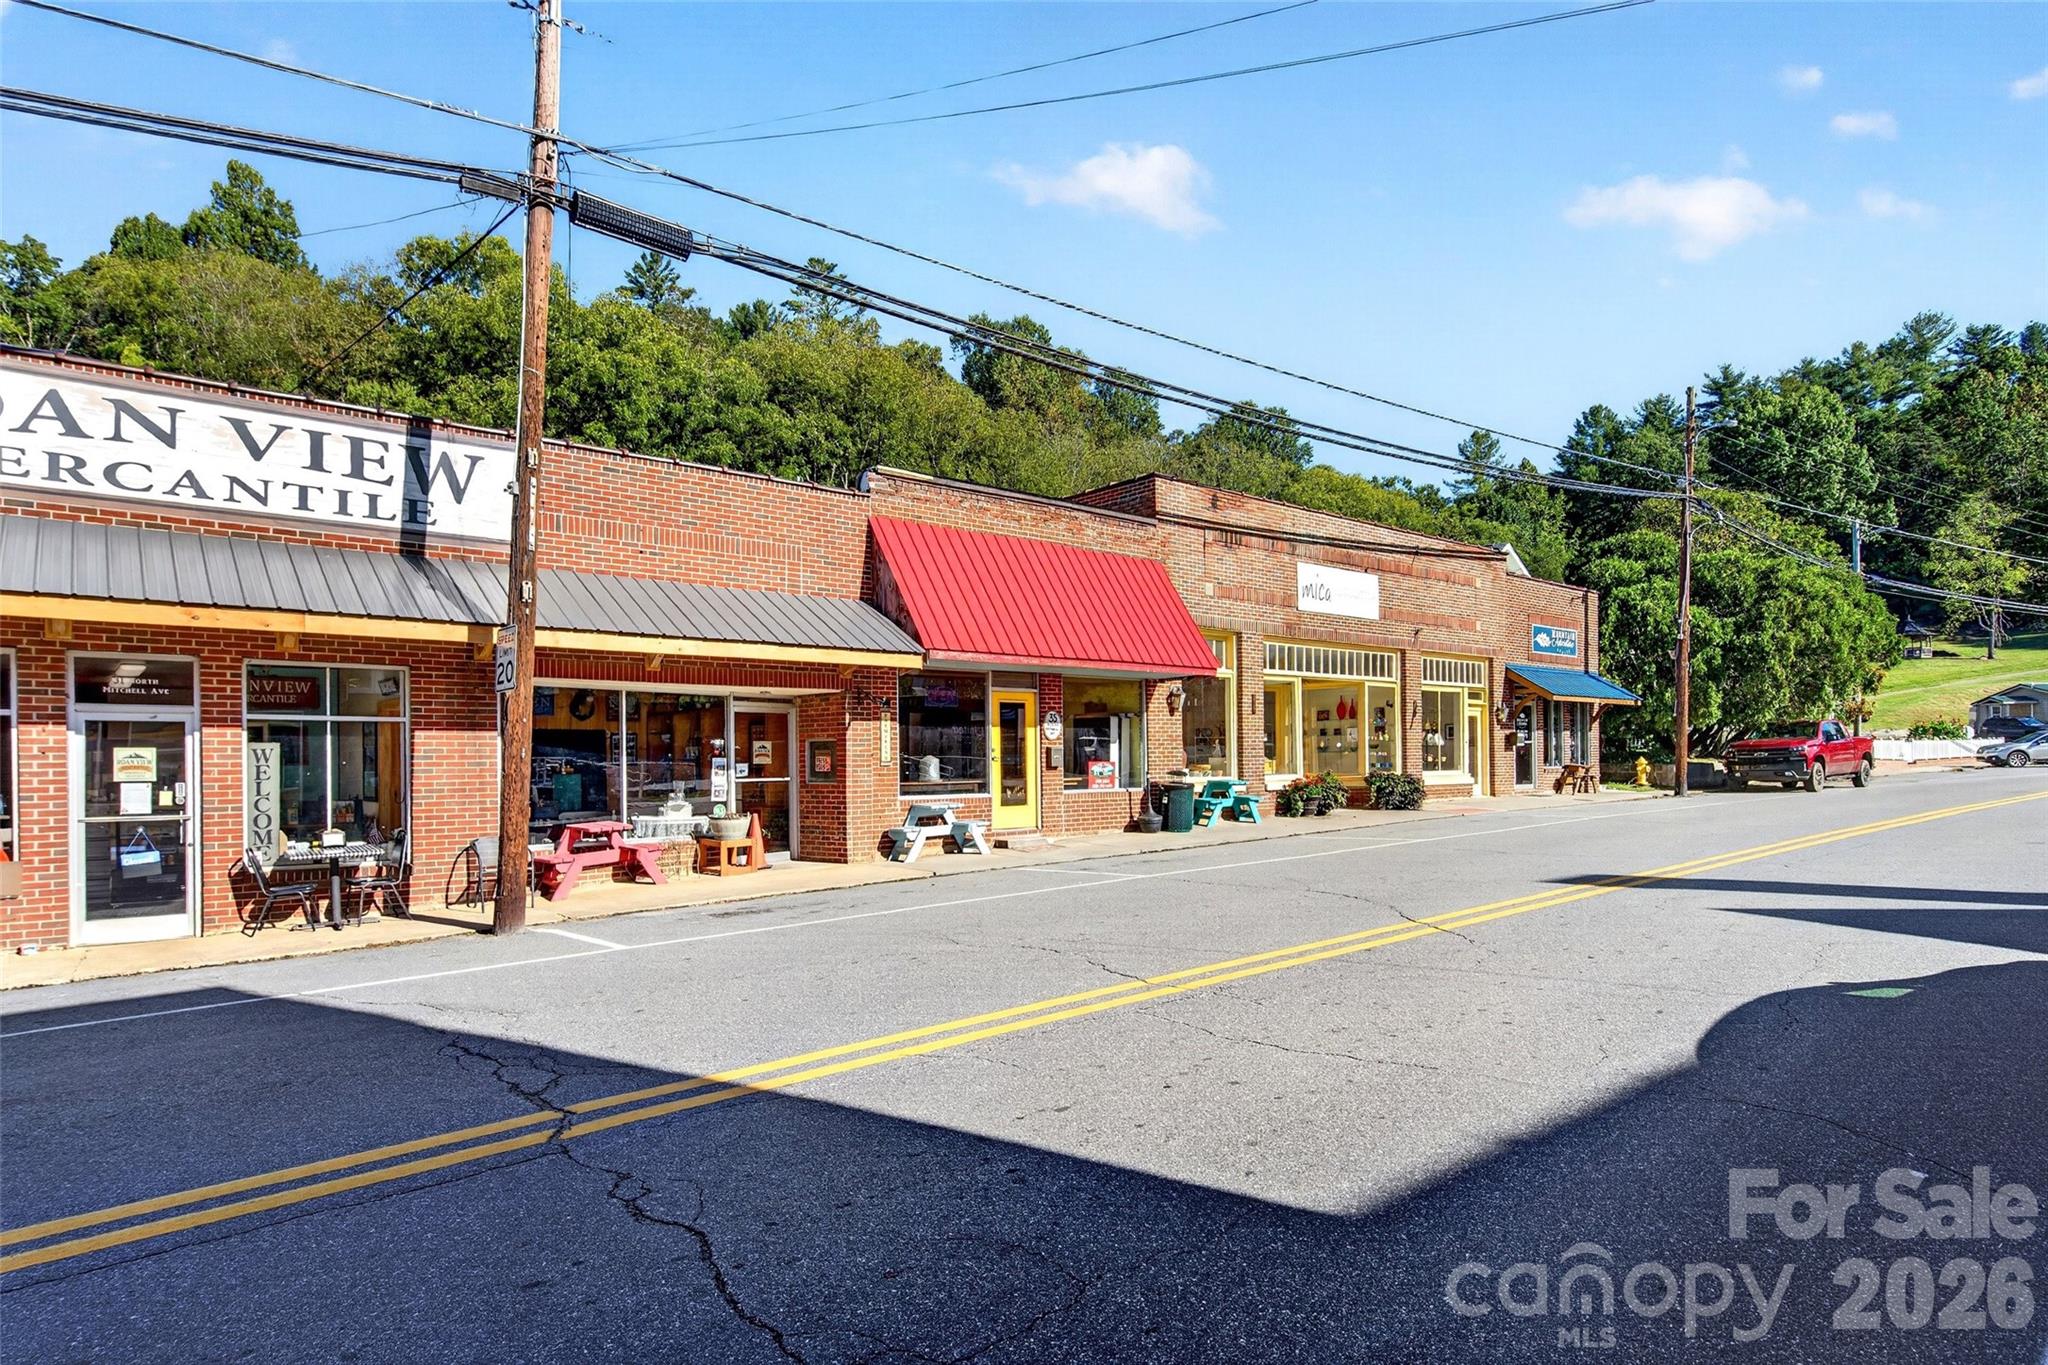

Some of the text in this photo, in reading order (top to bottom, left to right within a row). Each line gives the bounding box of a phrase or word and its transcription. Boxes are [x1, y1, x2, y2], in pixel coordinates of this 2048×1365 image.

[0, 389, 484, 504] AN VIEW
[1302, 573, 1331, 602] mica
[497, 660, 514, 685] 20
[251, 748, 274, 862] WELCOME
